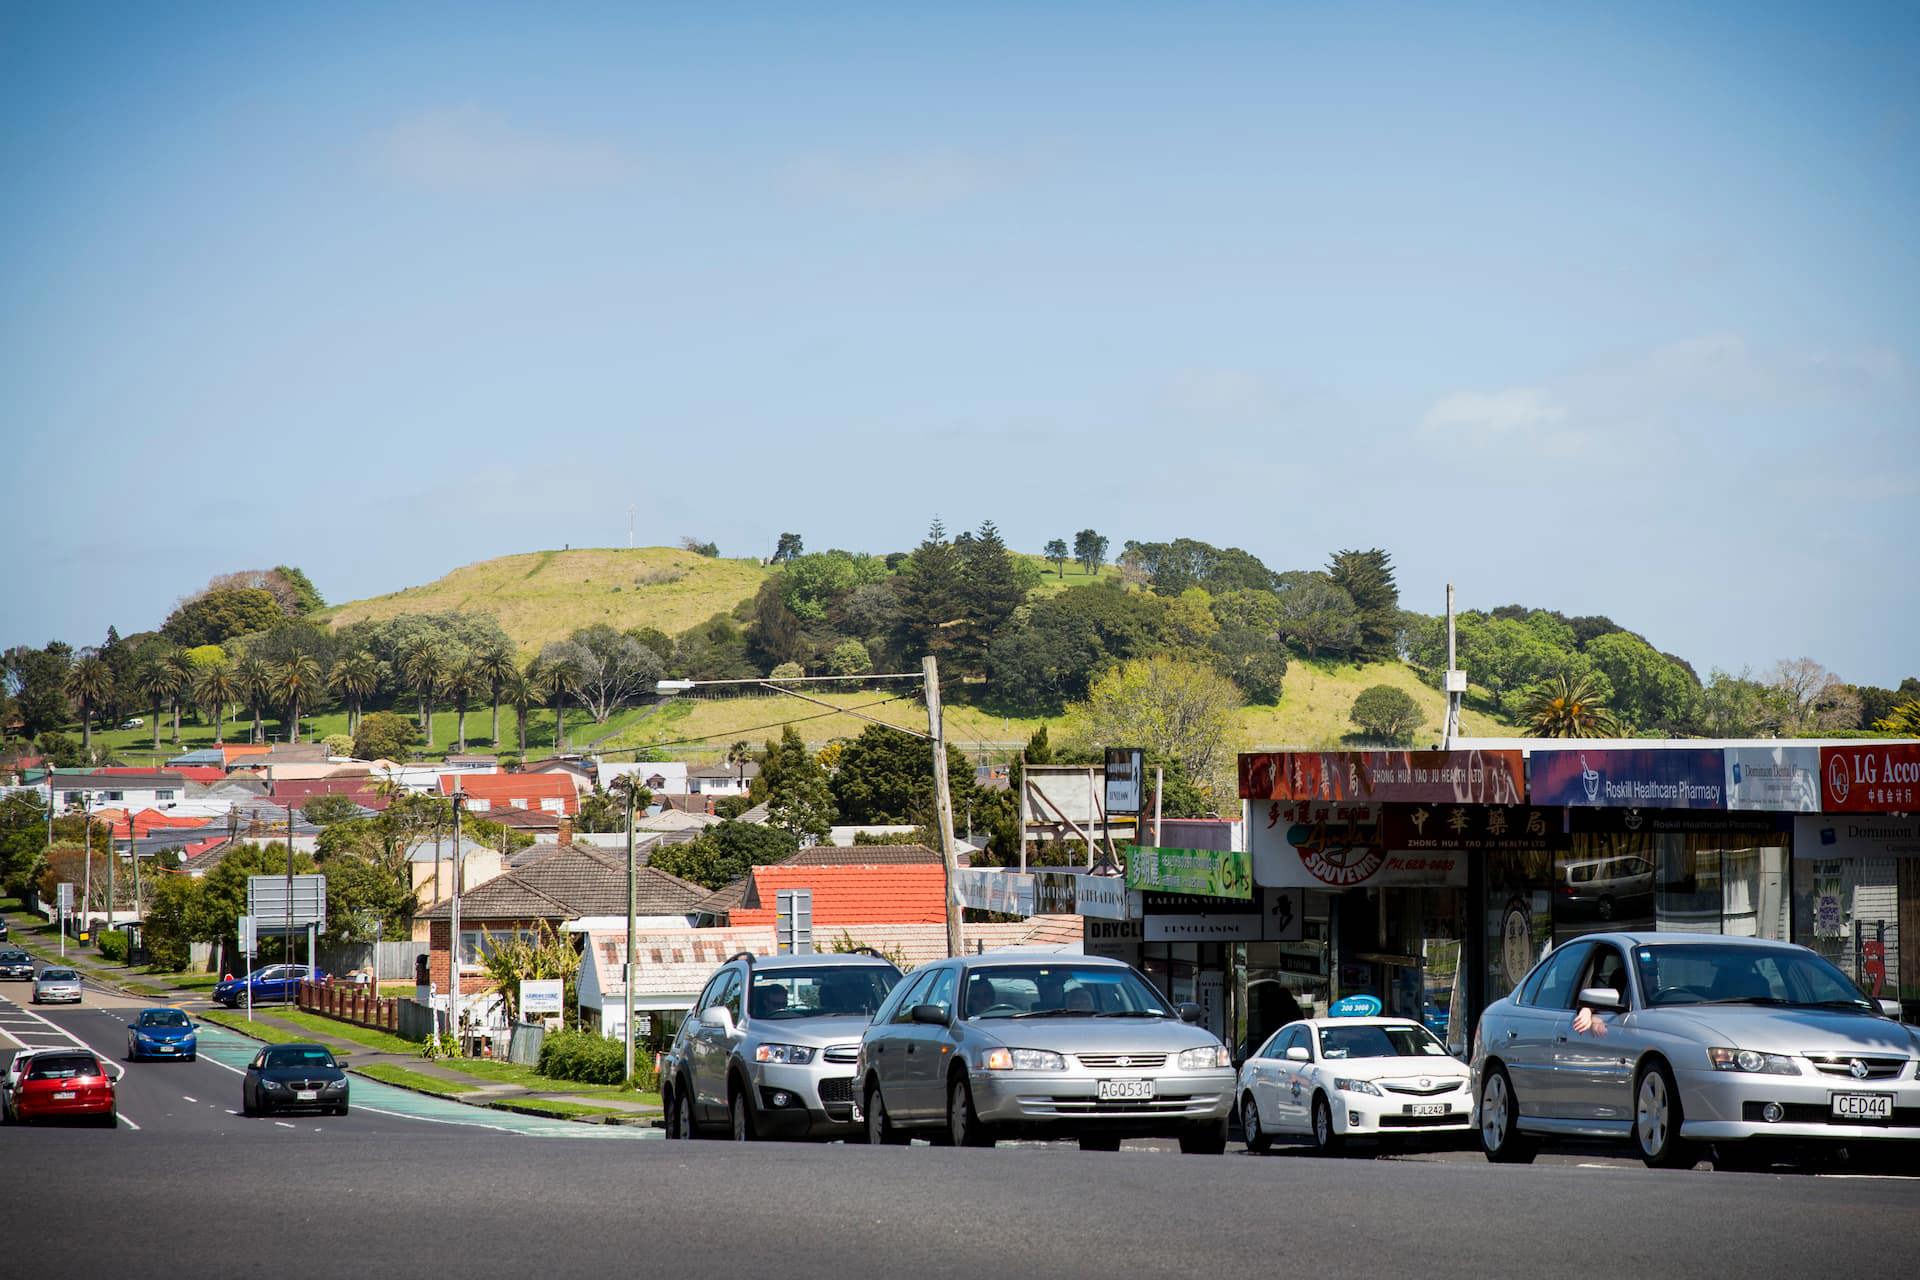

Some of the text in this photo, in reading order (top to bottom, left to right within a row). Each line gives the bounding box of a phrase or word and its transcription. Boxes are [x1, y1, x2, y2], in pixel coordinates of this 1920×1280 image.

[1373, 769, 1394, 784] ZHONG
[1397, 769, 1411, 784] HUA
[1415, 769, 1427, 784] YAO
[1431, 769, 1440, 784] JU
[1442, 769, 1466, 784] HEALTH
[1854, 752, 1920, 784] LG Acco
[1606, 781, 1720, 804] Roskill Healthcare Pharmacy
[1410, 807, 1546, 837] 中華藥局
[1848, 825, 1911, 838] Dominion
[1407, 839, 1546, 848] ZHONG HUA YAO JU HEALTH LTD
[1305, 852, 1382, 884] SOUVENIR
[1413, 1105, 1443, 1116] FJL242
[1839, 1097, 1886, 1115] CED44
